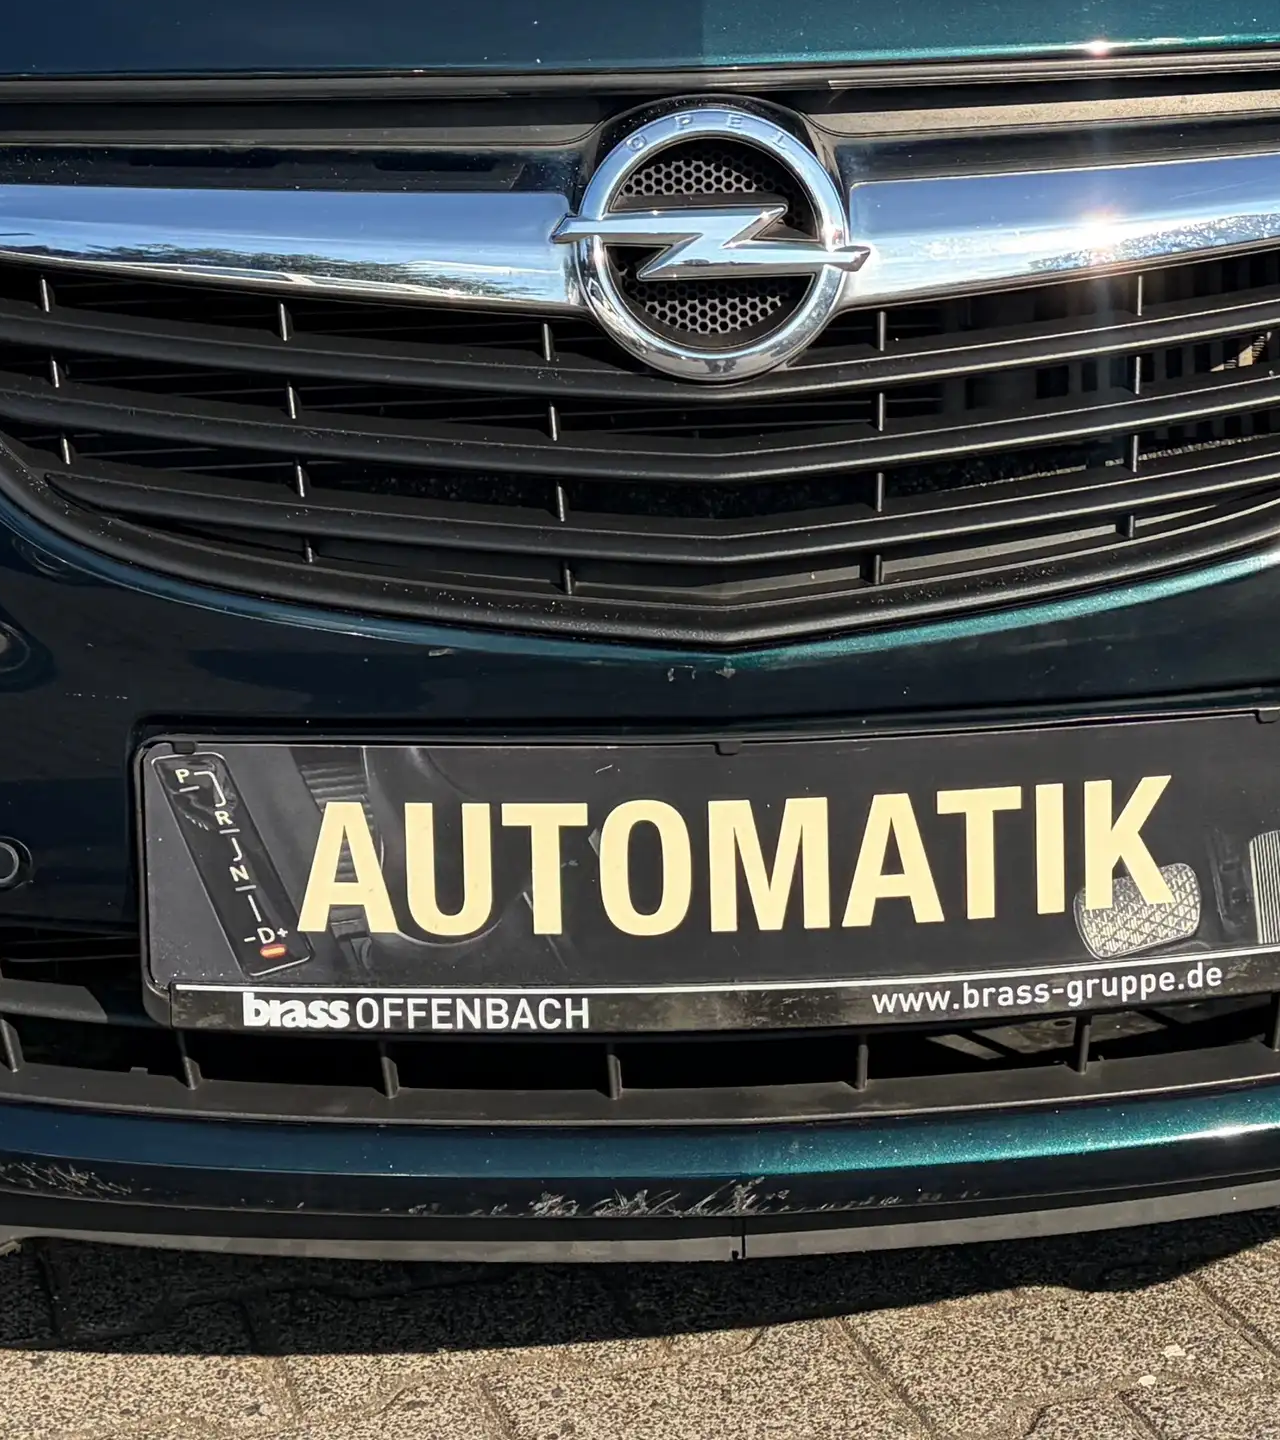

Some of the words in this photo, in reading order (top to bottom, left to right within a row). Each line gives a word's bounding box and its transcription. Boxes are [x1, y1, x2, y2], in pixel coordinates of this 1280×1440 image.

[625, 113, 792, 152] OPEL
[174, 768, 191, 784] P
[214, 810, 233, 826] R
[229, 864, 250, 882] N
[296, 773, 1174, 936] AUTOMATIK
[872, 962, 1223, 1014] www.brass-gruppe.de
[243, 991, 350, 1029] brass
[356, 997, 590, 1030] OFFENBACH
